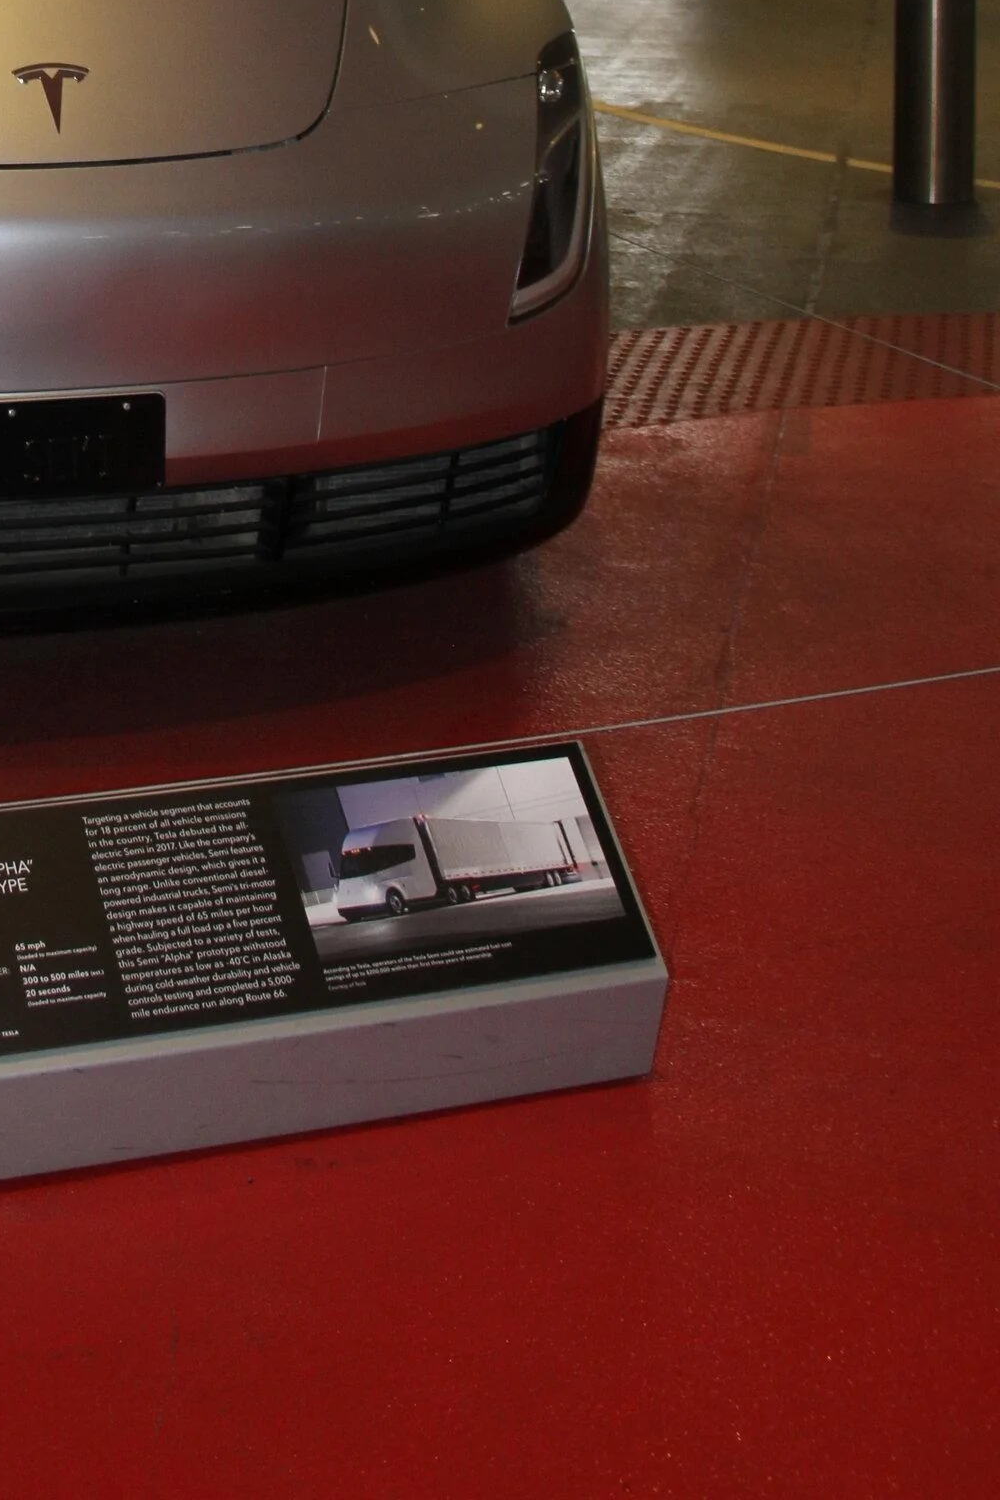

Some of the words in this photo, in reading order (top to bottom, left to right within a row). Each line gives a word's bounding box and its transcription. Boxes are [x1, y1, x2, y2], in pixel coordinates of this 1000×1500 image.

[81, 814, 122, 825] Targeting
[129, 808, 158, 819] vehicle
[159, 805, 196, 816] segment
[196, 802, 213, 811] that
[214, 798, 250, 809] accounts
[84, 827, 97, 836] for
[100, 825, 111, 834] 18
[112, 822, 147, 835] percent
[148, 819, 158, 829] of
[159, 818, 170, 828] all
[171, 815, 202, 826] vehicle
[204, 811, 246, 822] emissions
[87, 840, 97, 848] in
[98, 838, 114, 847] the
[153, 830, 177, 840] Tesla
[178, 824, 217, 837] debuted
[218, 823, 233, 832] the
[91, 850, 122, 860] electric
[123, 847, 145, 856] Semi
[178, 840, 195, 849] Like
[196, 838, 210, 847] the
[94, 860, 125, 872] electric
[126, 856, 169, 869] passenger
[207, 847, 229, 857] Semi
[229, 844, 263, 854] features
[110, 868, 166, 882] aerodynamic
[200, 859, 226, 870] which
[227, 858, 250, 869] gives
[251, 856, 258, 864] it
[99, 887, 121, 896] long
[152, 878, 180, 889] Unlike
[182, 870, 238, 885] conventional
[103, 894, 141, 909] powered
[142, 889, 181, 902] industrial
[239, 879, 275, 889] tri-motor
[105, 909, 136, 920] design
[138, 905, 167, 915] makes
[177, 898, 212, 911] capable
[214, 895, 223, 905] of
[225, 891, 276, 904] maintaining
[116, 920, 153, 932] highway
[155, 913, 183, 927] speed
[185, 911, 195, 922] of
[196, 910, 208, 920] 65
[210, 908, 234, 918] miles
[235, 907, 250, 917] per
[252, 904, 272, 912] hour
[111, 934, 136, 944] when
[136, 930, 169, 940] hauling
[176, 925, 190, 935] full
[191, 922, 211, 933] load
[212, 923, 224, 931] up
[232, 918, 247, 927] five
[249, 914, 281, 927] percent
[146, 937, 192, 952] Subjected
[213, 933, 242, 943] variety
[244, 928, 254, 939] of
[14, 942, 25, 951] 65
[27, 940, 45, 950] mph
[117, 959, 135, 968] this
[136, 956, 159, 966] Semi
[196, 946, 240, 960] prototype
[242, 937, 286, 951] withstood
[19, 963, 36, 972] N/A
[22, 975, 38, 985] 300
[50, 972, 66, 981] 500
[67, 970, 89, 979] miles
[121, 966, 182, 980] temperatures
[195, 962, 211, 970] low
[214, 960, 224, 968] as
[252, 955, 260, 963] in
[262, 950, 291, 961] Alaska
[124, 983, 154, 993] during
[154, 974, 209, 989] cold-weather
[211, 968, 251, 981] durability
[253, 965, 270, 975] and
[270, 961, 300, 972] vehicle
[25, 988, 36, 997] 20
[37, 984, 70, 995] seconds
[127, 993, 163, 1006] controls
[163, 990, 194, 1001] testing
[195, 985, 212, 996] and
[213, 979, 259, 994] completed
[131, 1007, 150, 1018] mile
[152, 1002, 199, 1015] endurance
[201, 1000, 217, 1008] run
[218, 996, 244, 1006] along
[245, 992, 271, 1002] Route
